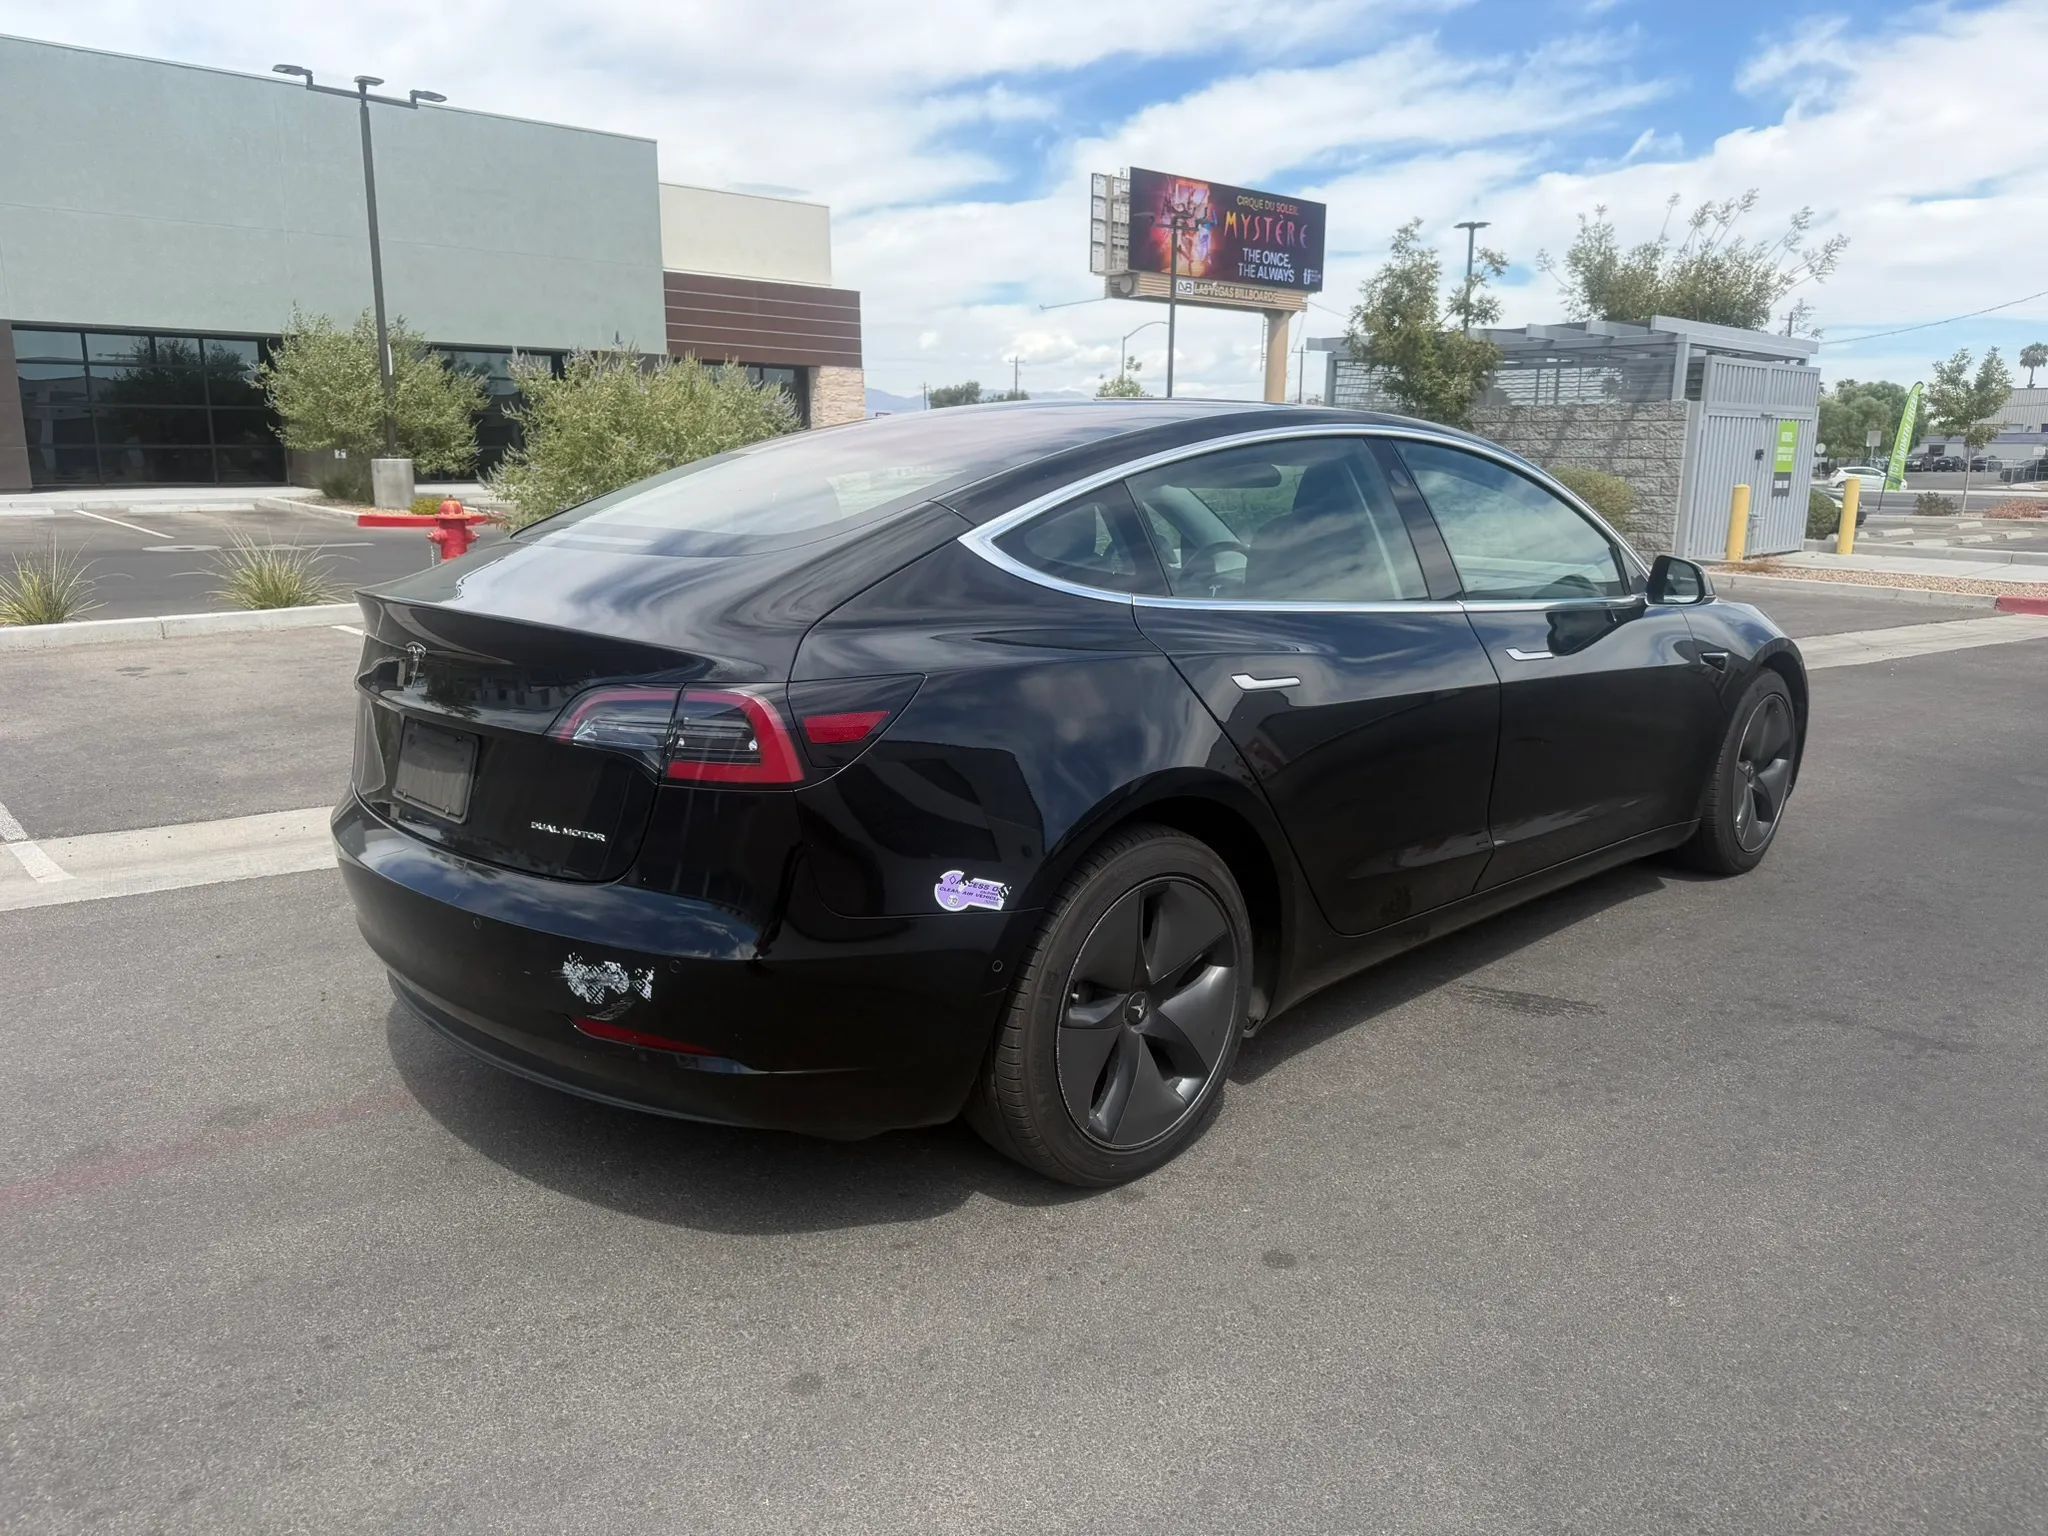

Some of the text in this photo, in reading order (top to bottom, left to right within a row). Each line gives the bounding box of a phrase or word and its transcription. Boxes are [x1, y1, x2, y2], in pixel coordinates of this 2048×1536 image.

[1236, 195, 1263, 211] CIRQUE
[1264, 200, 1275, 211] DU
[1223, 211, 1308, 249] MYSTÈRE
[1242, 247, 1291, 269] THE ONCE,
[1238, 262, 1256, 278] THE
[1256, 265, 1295, 283] ALWAYS
[1194, 281, 1279, 304] LAS VEGAS BILLBOARDS
[530, 821, 606, 842] DUAL MOTOR
[956, 879, 990, 891] ACESS
